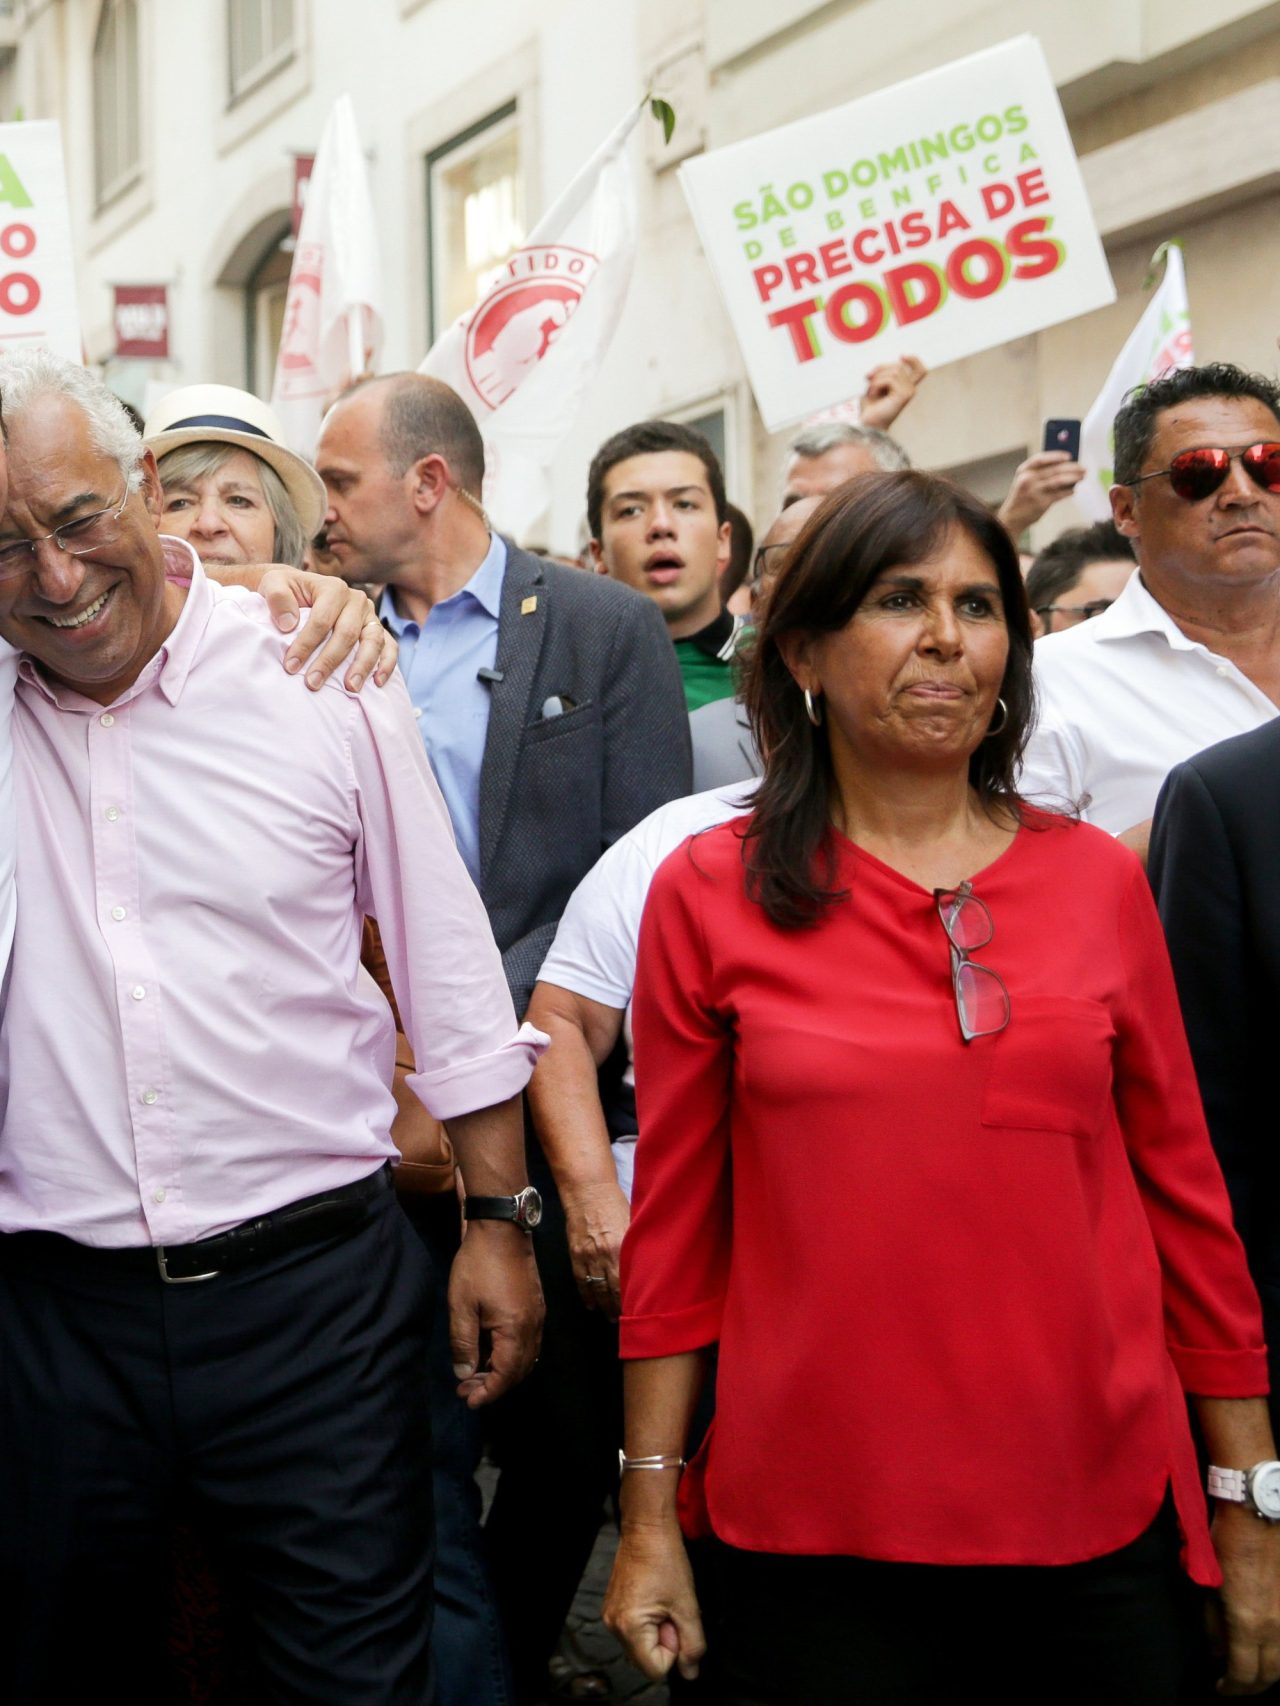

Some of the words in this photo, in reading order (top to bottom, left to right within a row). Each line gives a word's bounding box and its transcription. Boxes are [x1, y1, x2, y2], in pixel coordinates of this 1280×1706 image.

[733, 183, 814, 230] SÃO
[822, 105, 1029, 199] DOMINGOS
[742, 227, 797, 260] DE
[825, 142, 1038, 232] BENFICA
[752, 198, 971, 303] PRECISA
[980, 167, 1050, 221] DE
[767, 216, 1066, 363] TODOS
